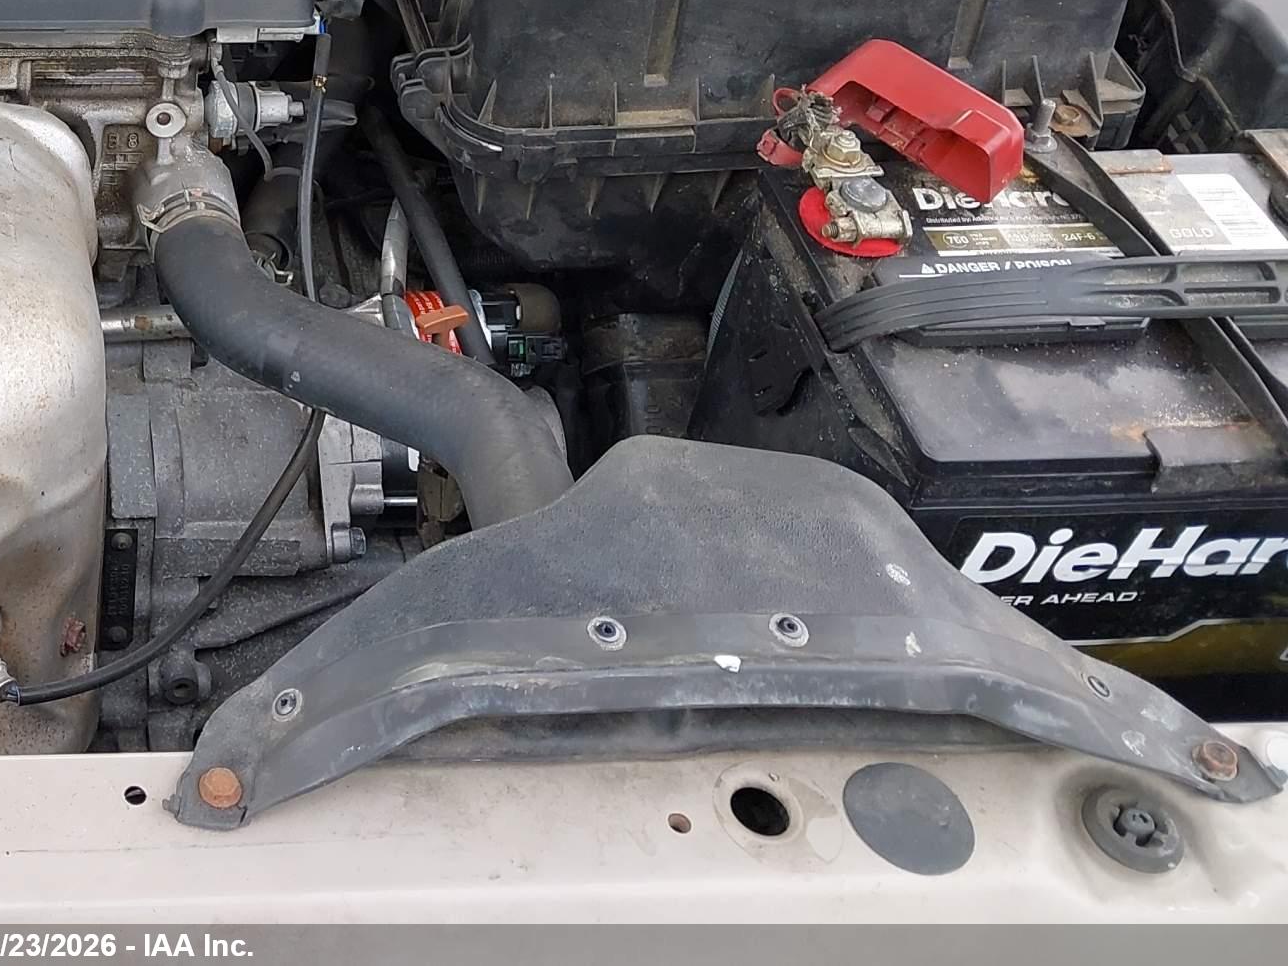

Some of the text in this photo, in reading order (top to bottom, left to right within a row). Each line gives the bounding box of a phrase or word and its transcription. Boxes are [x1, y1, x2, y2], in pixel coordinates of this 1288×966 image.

[912, 186, 1071, 212] Diear
[1169, 226, 1214, 239] GOLD
[934, 261, 1001, 274] DANGER
[960, 525, 1288, 584] DieHar
